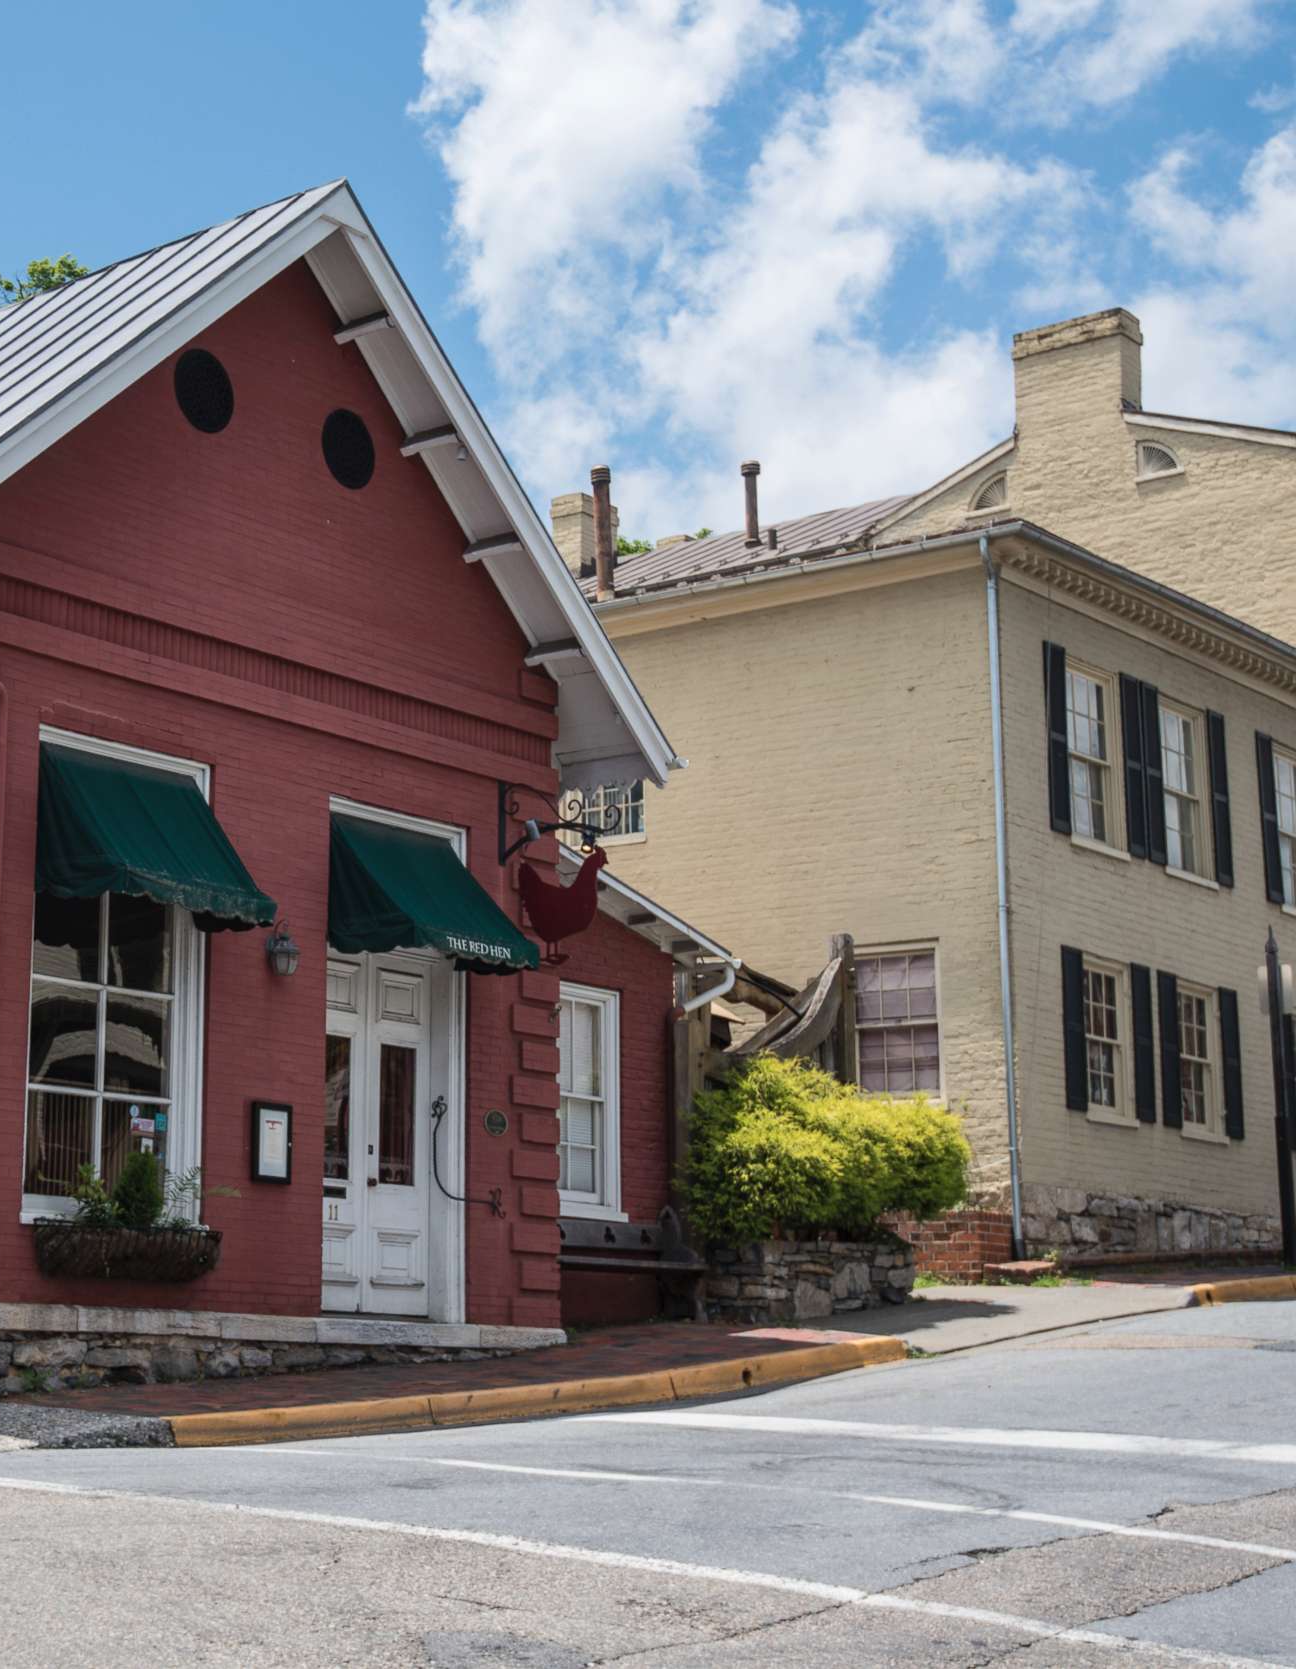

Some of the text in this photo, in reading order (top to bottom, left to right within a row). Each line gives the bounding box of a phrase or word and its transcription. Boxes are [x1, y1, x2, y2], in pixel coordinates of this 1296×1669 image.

[446, 935, 512, 960] THE RED HEN
[328, 1204, 338, 1221] 11
